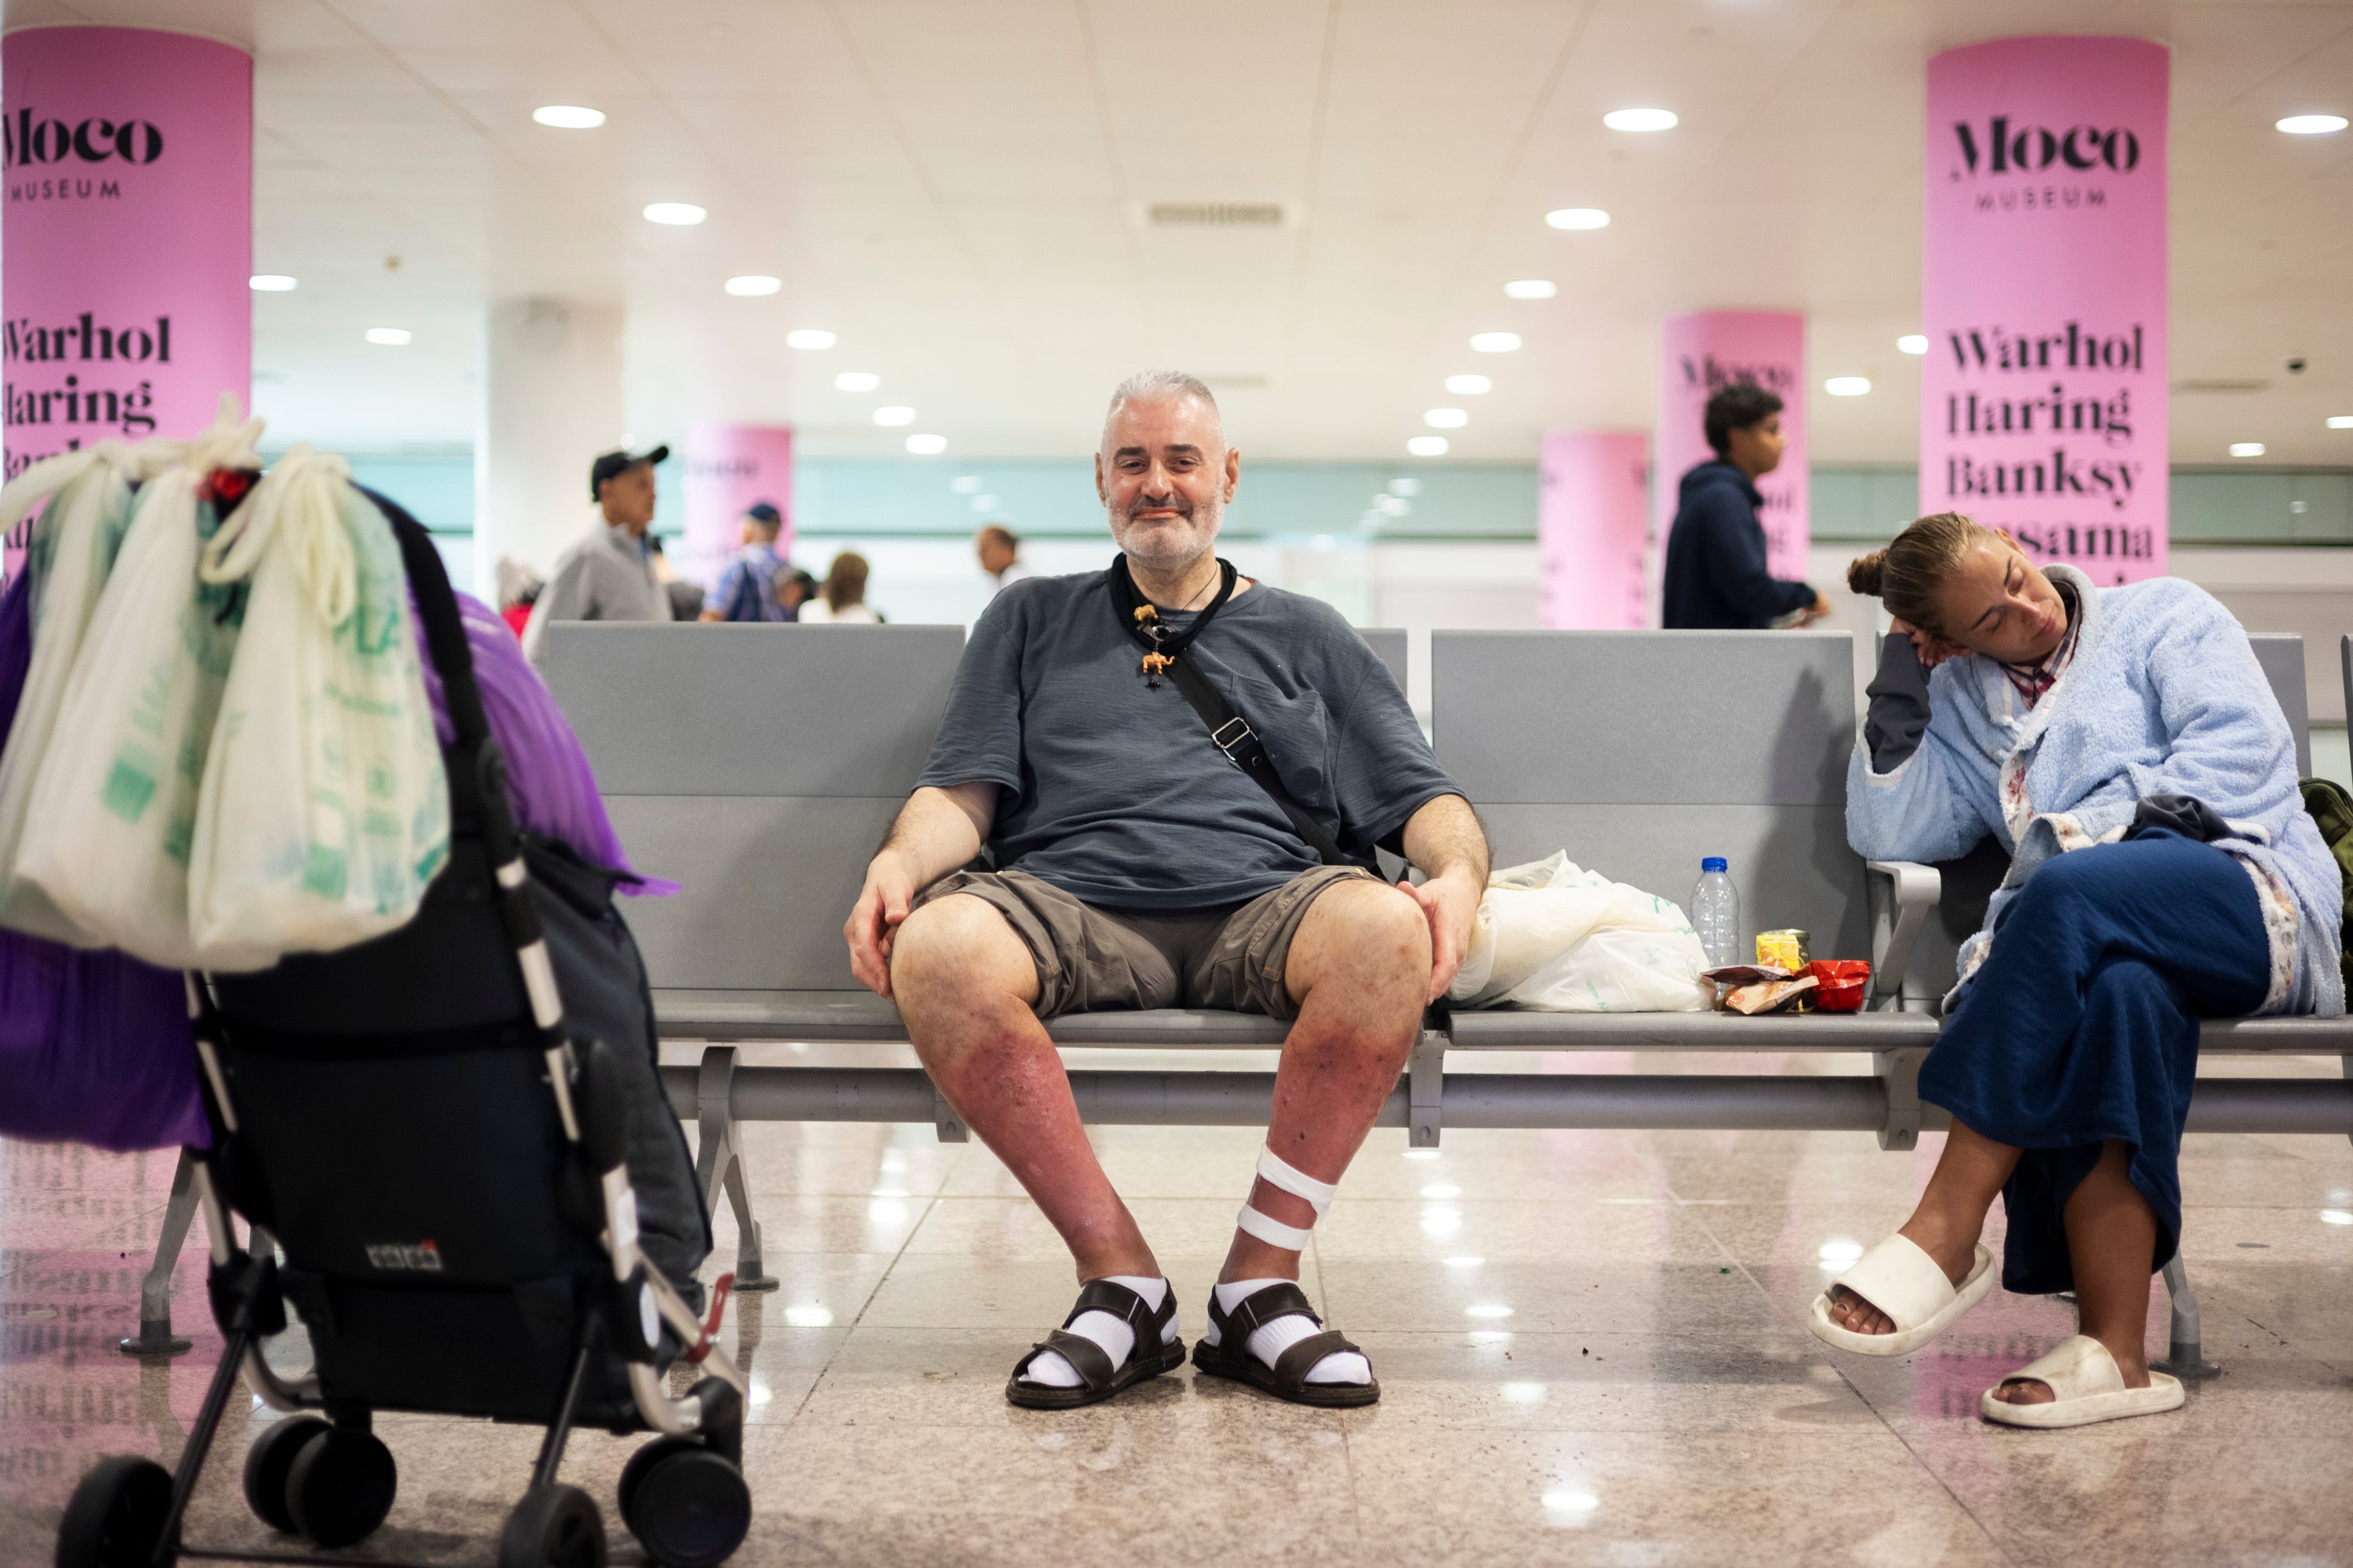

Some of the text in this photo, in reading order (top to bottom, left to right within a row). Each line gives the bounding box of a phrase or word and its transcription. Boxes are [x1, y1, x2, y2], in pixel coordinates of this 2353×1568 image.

[1950, 114, 2140, 181] Moco
[12, 178, 121, 201] MUSEUM
[1975, 186, 2106, 210] MUSEUM
[1947, 320, 2143, 371] Warhol
[1947, 384, 2134, 446] Haring
[1947, 447, 2142, 507] Banksy
[1999, 521, 2154, 559] sama
